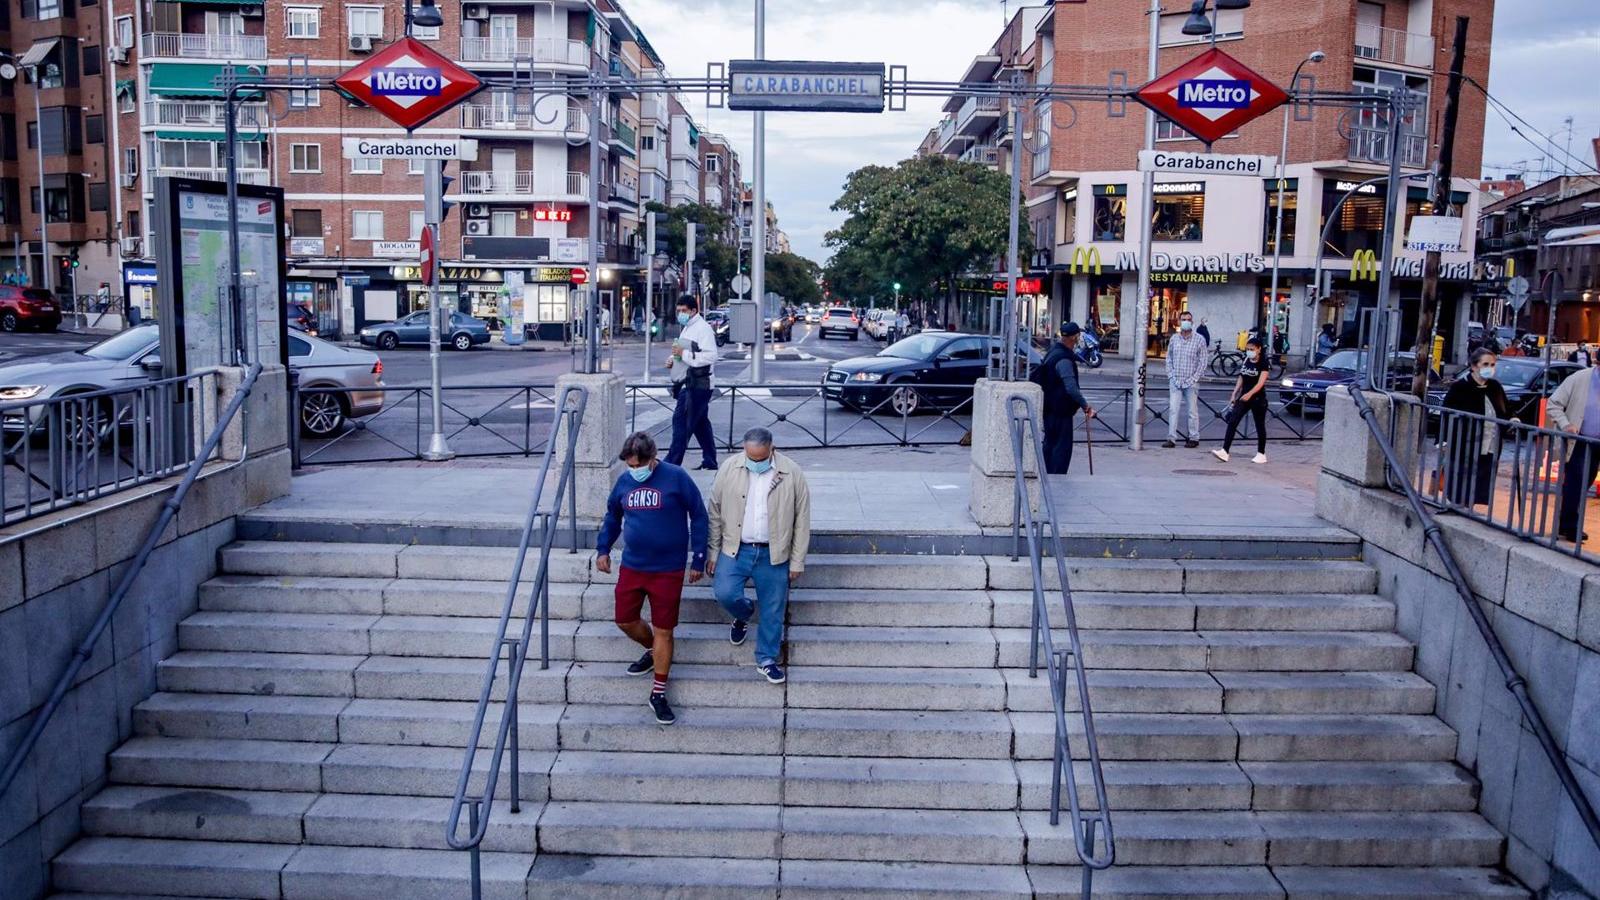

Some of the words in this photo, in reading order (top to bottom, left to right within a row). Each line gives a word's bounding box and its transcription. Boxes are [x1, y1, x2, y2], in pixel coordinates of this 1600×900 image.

[376, 71, 437, 92] Metro
[744, 77, 868, 94] CARABANCHEL
[1184, 83, 1246, 103] Metro
[358, 141, 456, 157] Carabanchel
[1154, 153, 1262, 173] Carabanchel
[1114, 251, 1266, 273] MDonald's
[405, 266, 481, 279] PAAZZO
[1149, 272, 1228, 284] RESTAURANTE
[628, 490, 658, 507] GANSO
